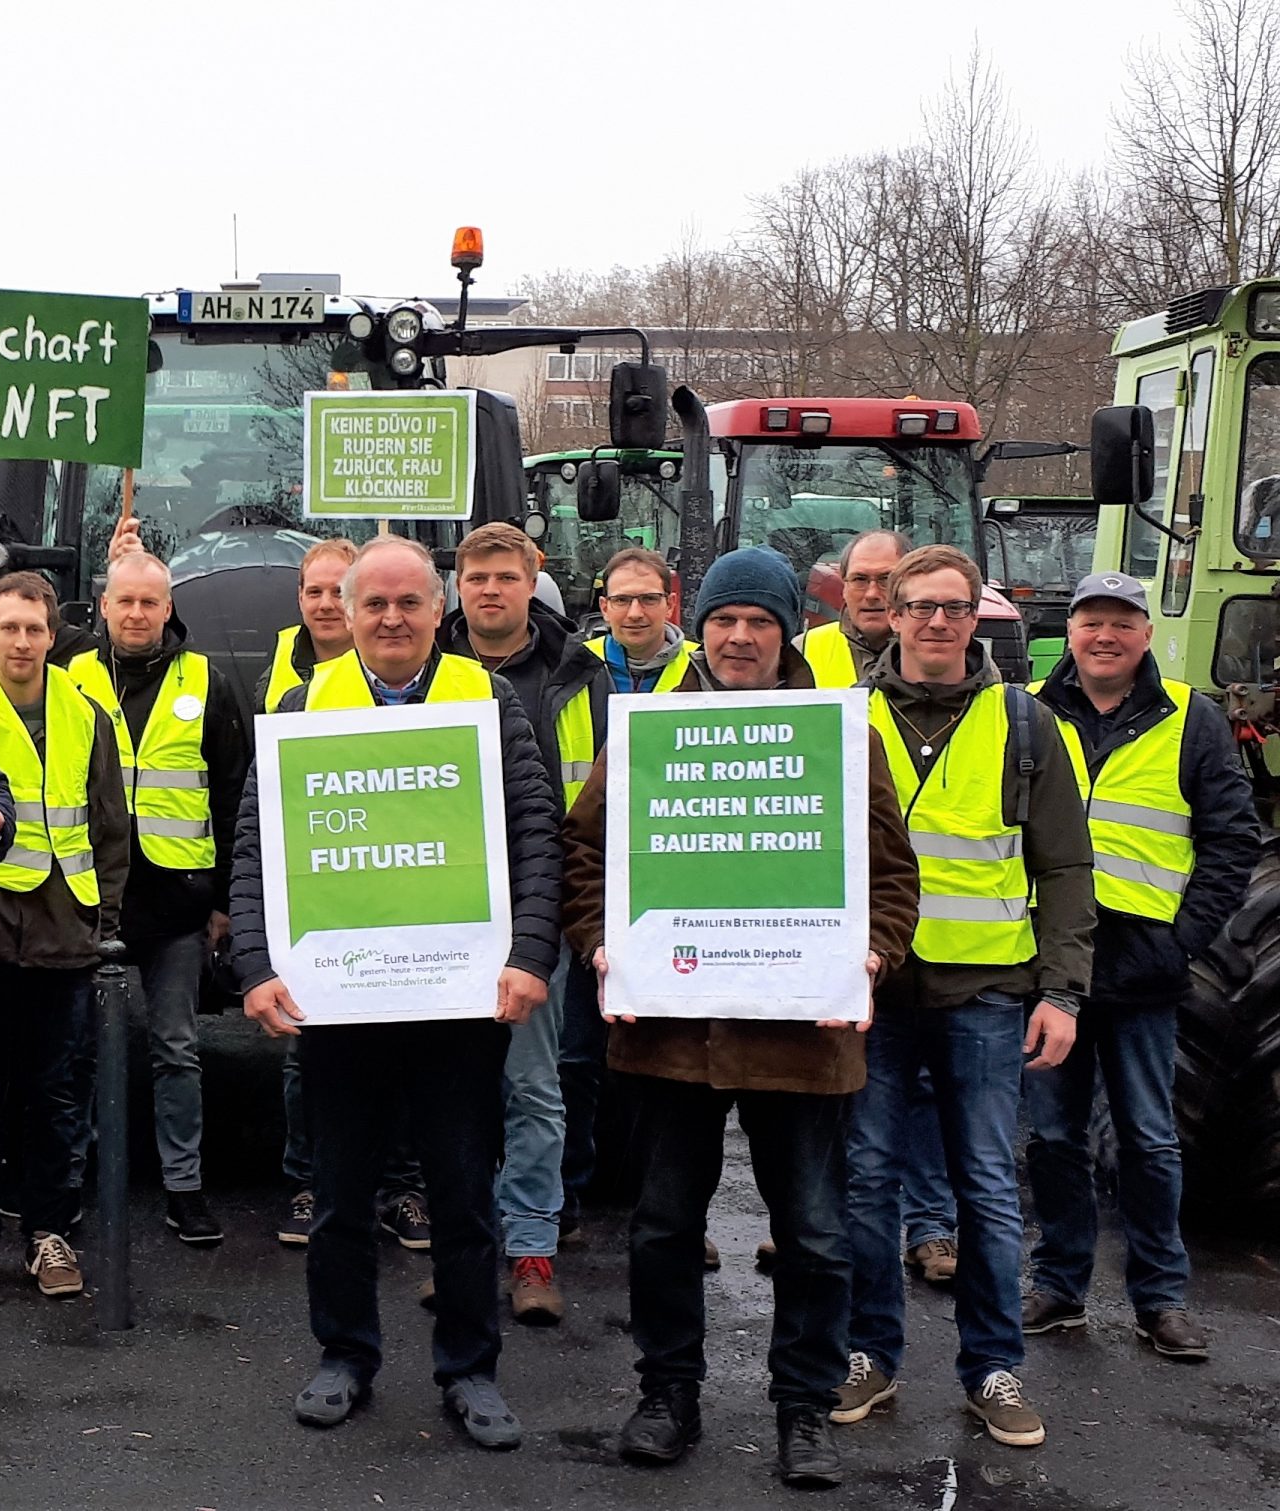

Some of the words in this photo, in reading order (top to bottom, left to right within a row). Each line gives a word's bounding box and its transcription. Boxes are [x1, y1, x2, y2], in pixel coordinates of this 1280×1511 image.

[201, 296, 232, 319] AH
[248, 296, 263, 319] N
[270, 296, 314, 319] 174
[330, 416, 373, 434] KEINE
[377, 412, 422, 434] DÜVO
[343, 437, 405, 455] RUDERN
[410, 437, 433, 455] SIE
[333, 455, 398, 478] ZURÜCK,
[402, 458, 442, 476] FRAU
[345, 476, 429, 497] KLÖCKNER!
[675, 726, 738, 751] JULIA
[743, 723, 794, 746] UND
[665, 762, 706, 782] IHR
[711, 755, 805, 782] ROMEU
[305, 763, 461, 798] FARMERS
[648, 797, 747, 818] MACHEN
[753, 795, 824, 816] KEINE
[307, 808, 368, 835] FOR
[650, 833, 743, 853] BAUERN
[750, 831, 823, 852] FROH!
[310, 841, 446, 874] FUTURE!
[314, 956, 340, 968] Echt
[342, 948, 384, 977] Grün
[412, 950, 470, 963] Landwirte
[702, 948, 751, 959] Landvolk
[753, 948, 802, 960] Diepholz
[340, 976, 447, 989] www.eure-landwirte.de
[359, 968, 387, 977] gestern
[390, 967, 411, 975] heute
[415, 965, 443, 974] morgen
